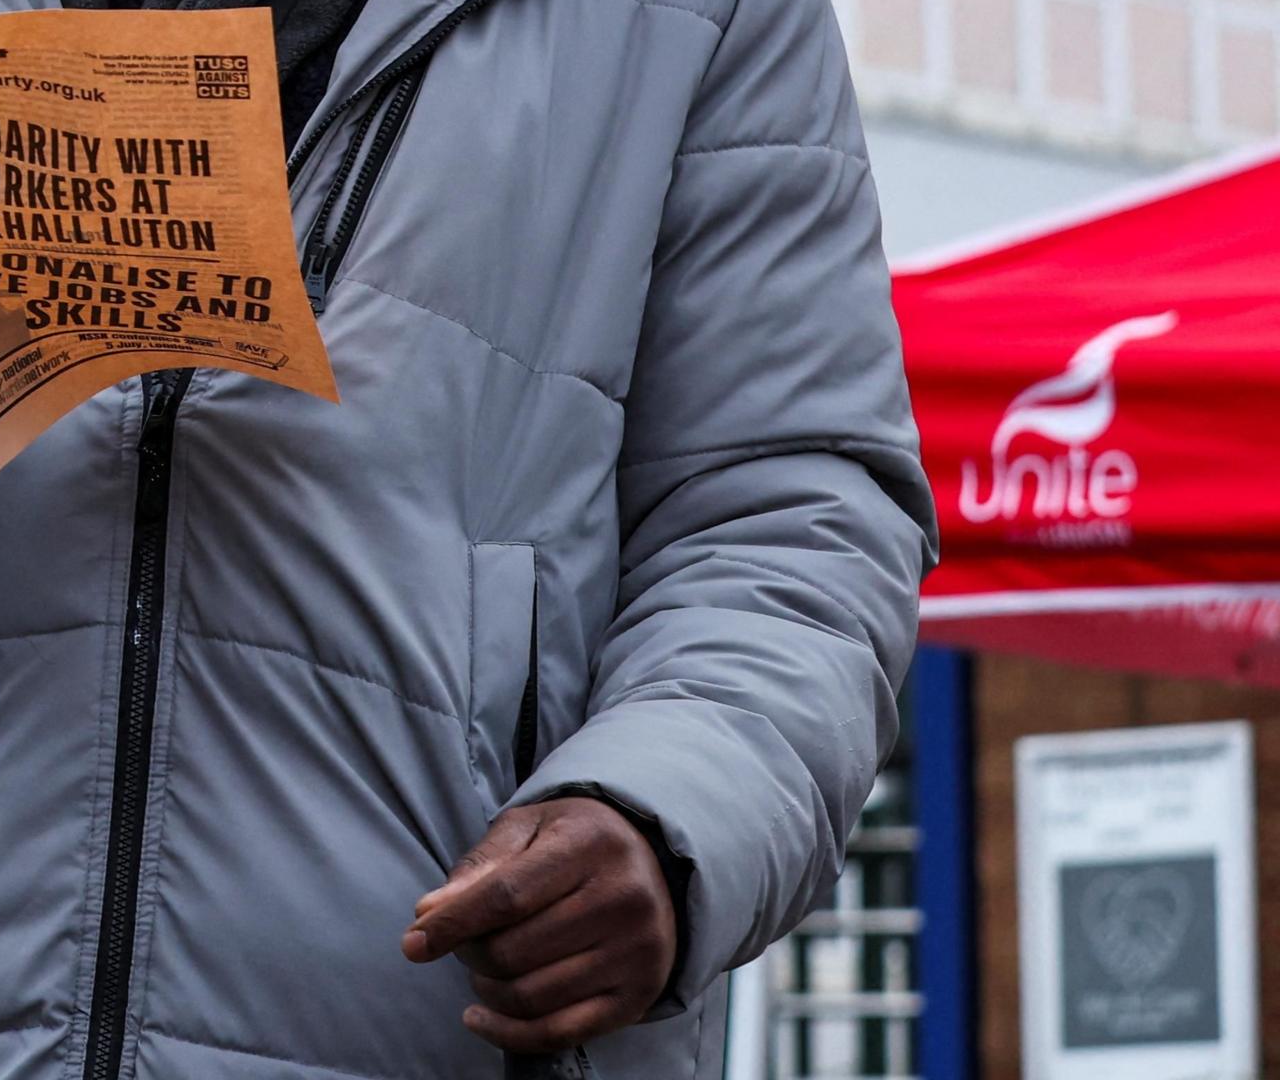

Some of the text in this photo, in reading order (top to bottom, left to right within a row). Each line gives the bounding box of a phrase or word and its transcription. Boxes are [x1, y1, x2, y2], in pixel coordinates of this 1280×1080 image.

[195, 57, 247, 70] TUSC
[196, 71, 248, 83] AGAINST
[197, 86, 250, 98] CUTS
[115, 137, 213, 177] WITH
[131, 178, 171, 215] AT
[101, 216, 217, 252] LUTON
[43, 280, 157, 308] JOBS
[175, 295, 272, 322] AND
[217, 273, 272, 301] TO
[26, 299, 183, 333] SKILLS
[105, 342, 114, 350] 5
[149, 342, 194, 351] London
[111, 333, 181, 343] conference
[1, 346, 43, 381] national
[958, 448, 1138, 524] unite
